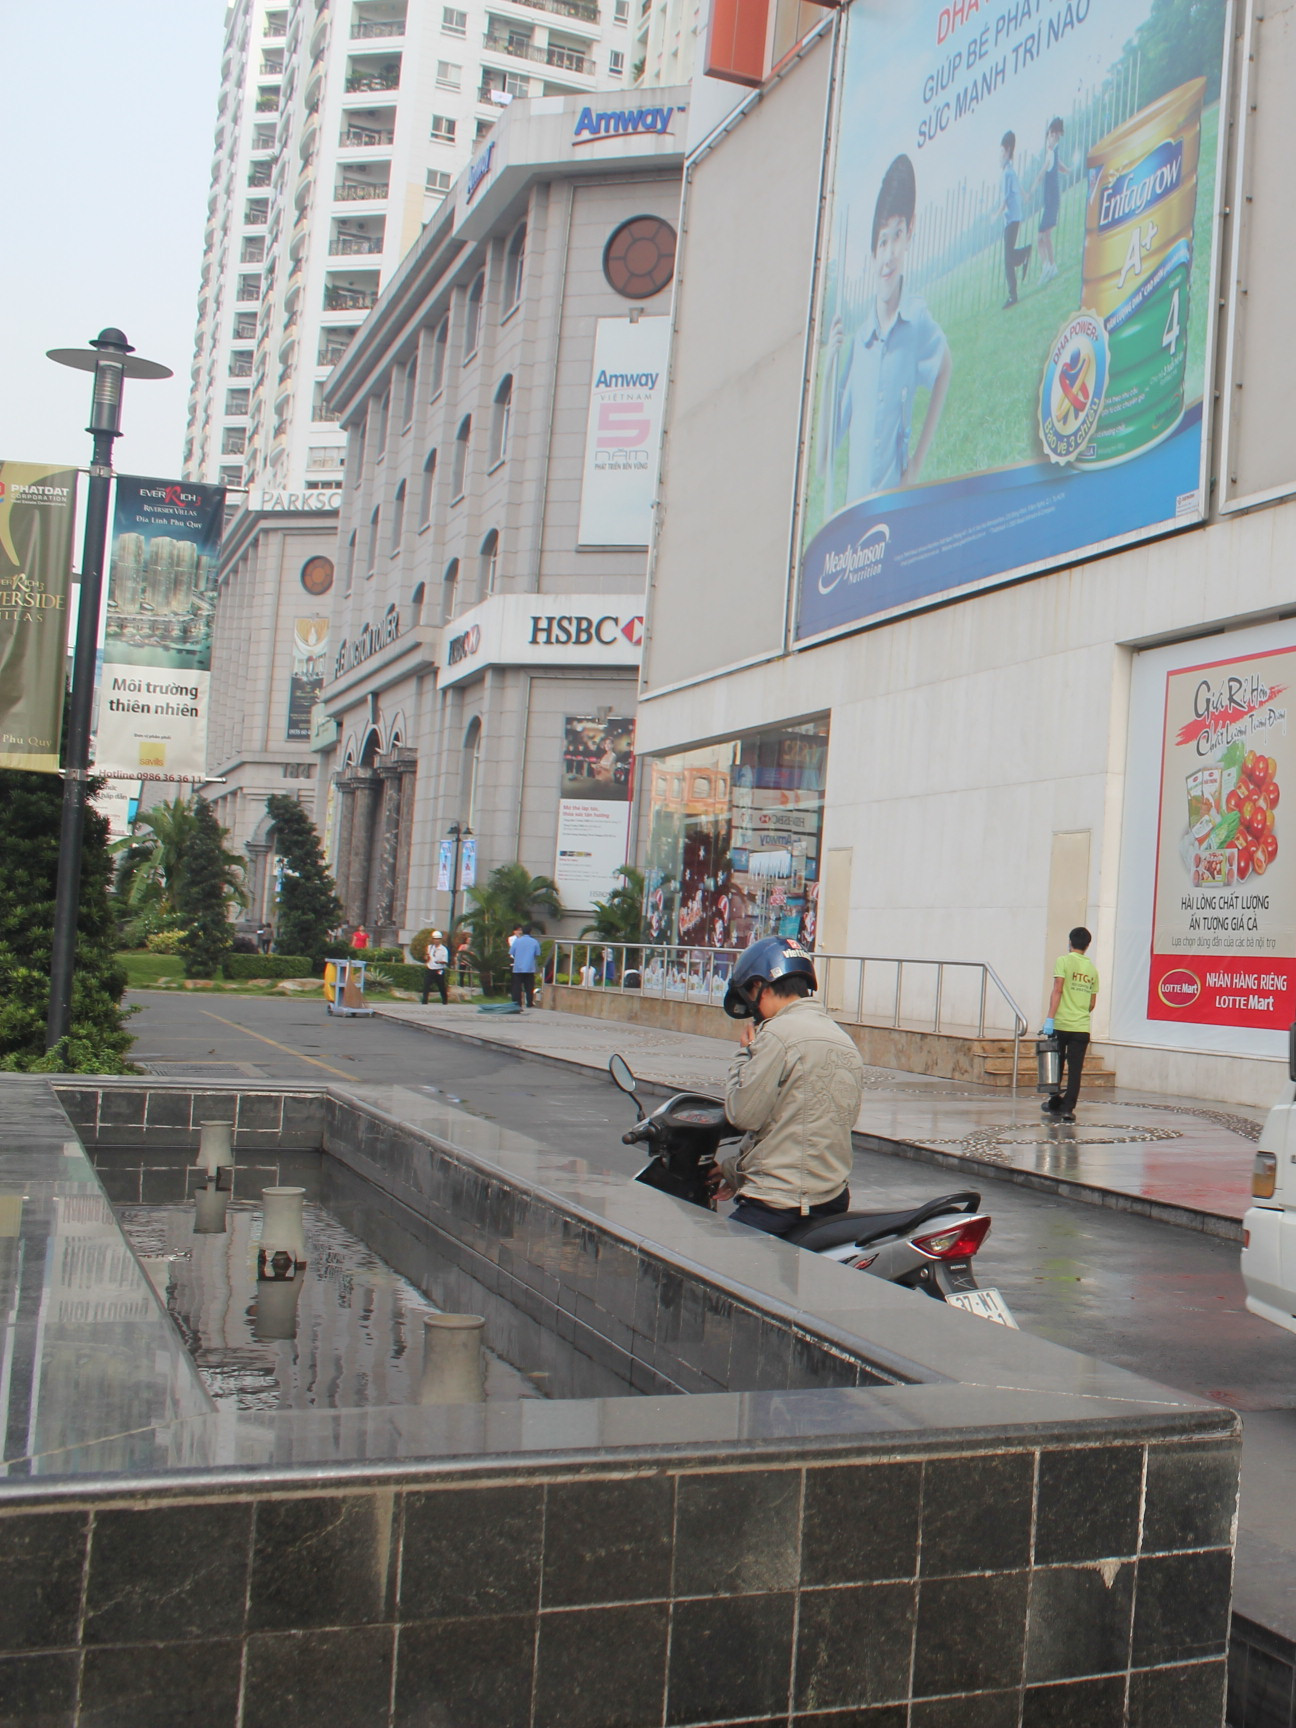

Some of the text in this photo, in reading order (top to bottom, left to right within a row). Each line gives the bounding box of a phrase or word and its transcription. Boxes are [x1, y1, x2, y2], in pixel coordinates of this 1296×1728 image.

[922, 51, 962, 104] GIÚP
[966, 21, 990, 70] BÉ
[917, 101, 951, 149] SỨC
[954, 54, 1006, 122] MẠNH
[1012, 19, 1043, 75] TRÍ
[574, 106, 673, 135] Amway
[1100, 155, 1181, 225] Enfagrow
[1162, 287, 1180, 355] 4
[1053, 336, 1069, 366] DHA
[595, 370, 659, 390] Amway
[596, 402, 652, 448] 5
[11, 484, 69, 496] PHATDAT
[11, 493, 67, 502] CORPORATION
[262, 491, 342, 510] PARKSO
[848, 563, 882, 585] Nutrition
[529, 616, 619, 646] HSBC
[112, 677, 199, 700] Môi trường
[109, 698, 199, 718] thiên nhiên
[1194, 679, 1225, 721] Giá
[99, 769, 134, 780] Hotline
[136, 771, 161, 781] 0986
[1181, 891, 1270, 913] HÀI LÒNG CHẤT LƯỢNG
[1189, 912, 1258, 934] ẤN TƯỢNG GIÁ CẢ
[1161, 982, 1198, 994] LOTTE Mart
[1232, 971, 1258, 990] HÀNG
[1260, 972, 1288, 991] RIÊNG
[1215, 994, 1274, 1011] LOTTE Mart
